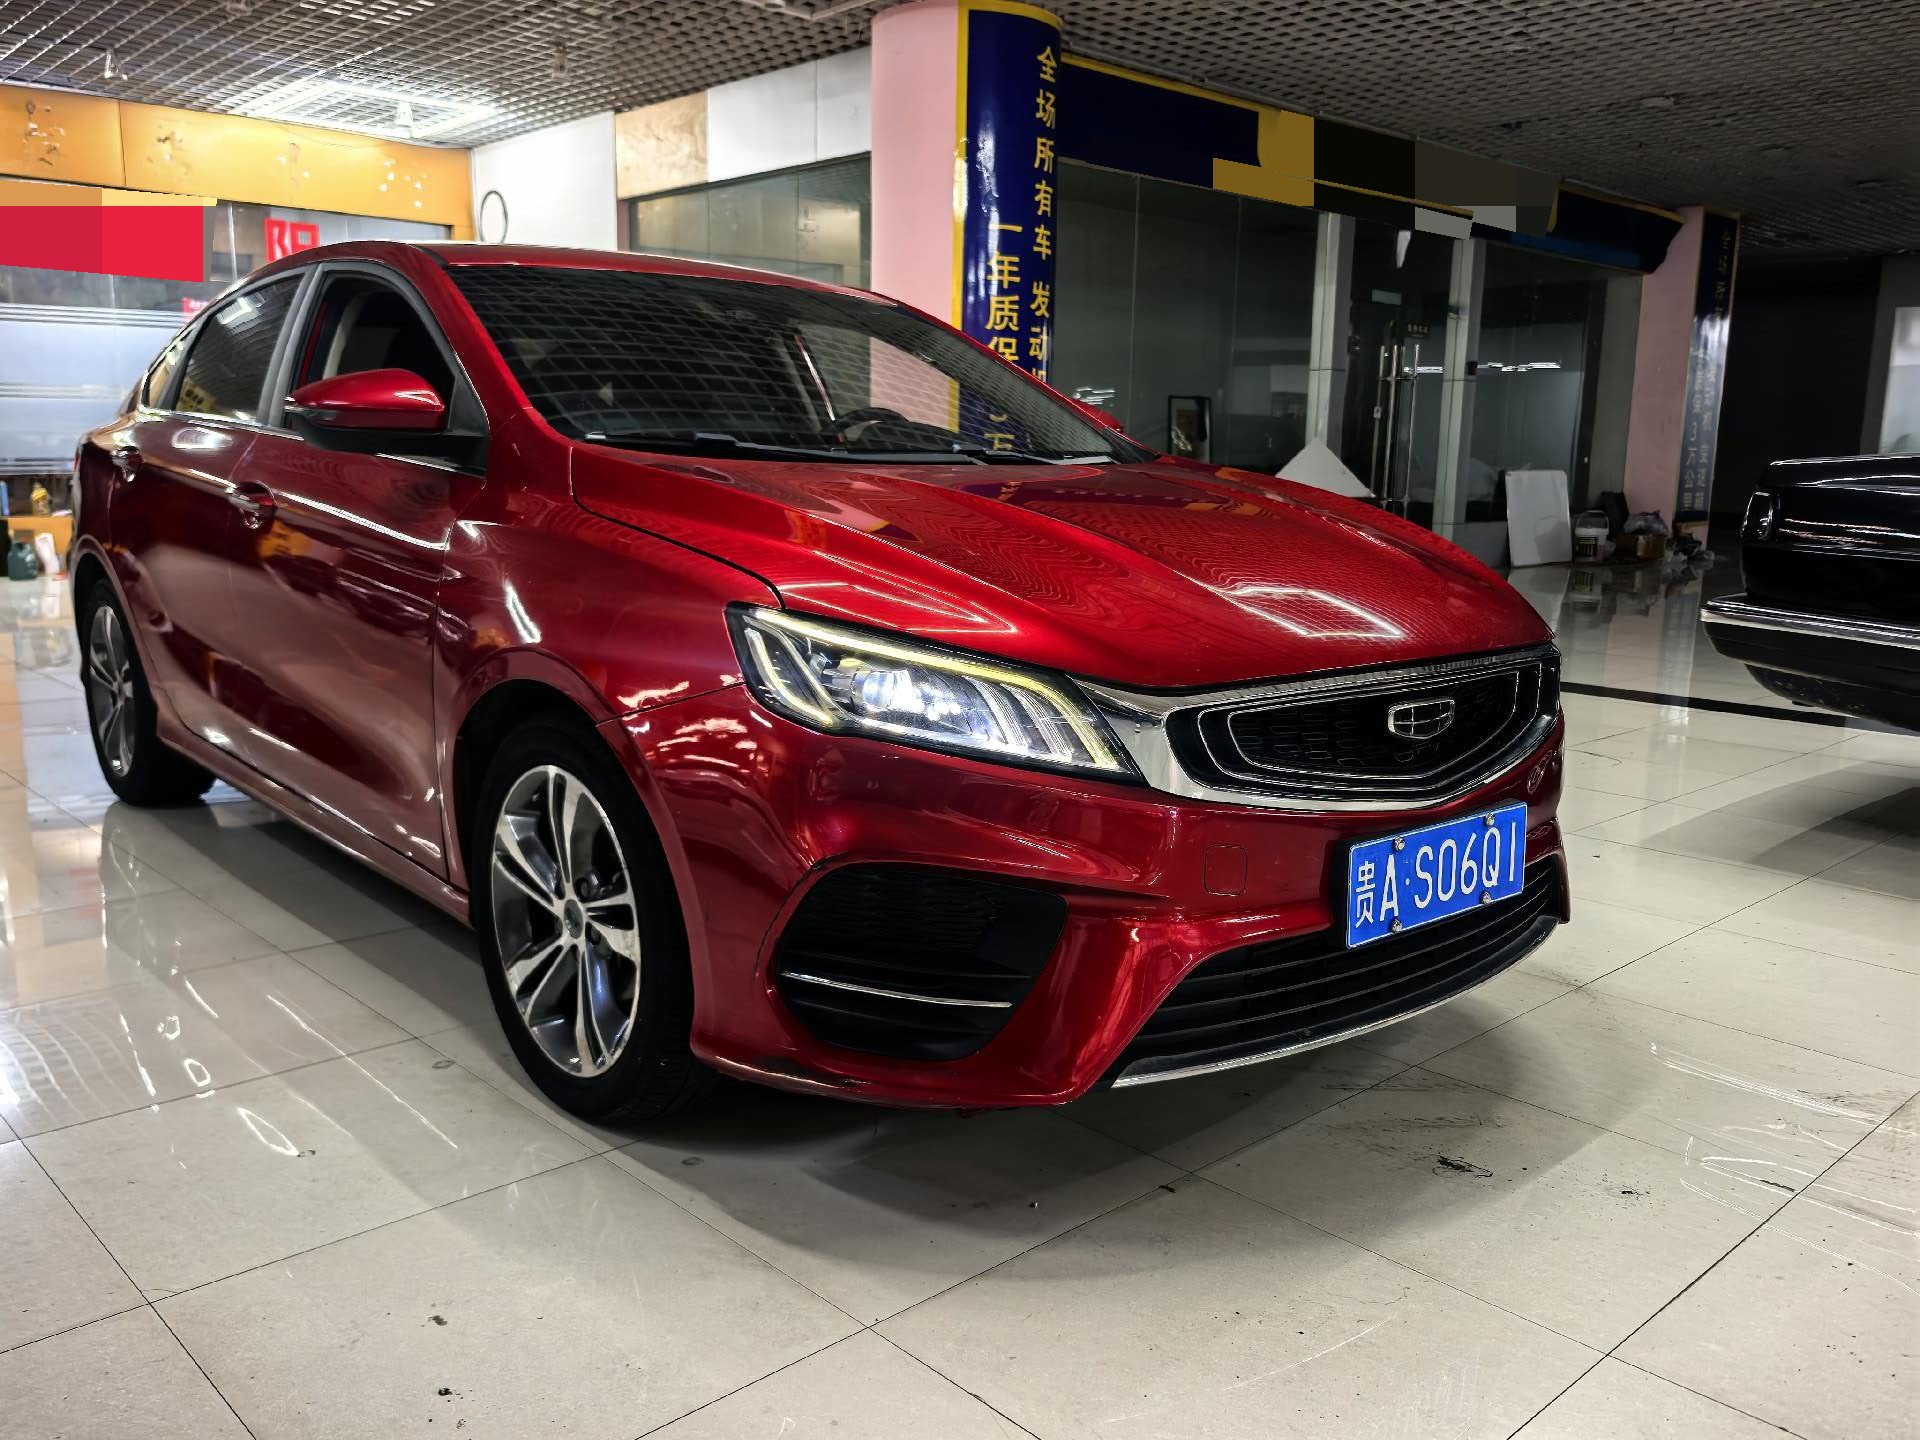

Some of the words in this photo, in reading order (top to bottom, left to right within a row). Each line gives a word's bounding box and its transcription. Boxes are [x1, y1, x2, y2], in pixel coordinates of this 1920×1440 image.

[1032, 46, 1057, 261] 全场所有车
